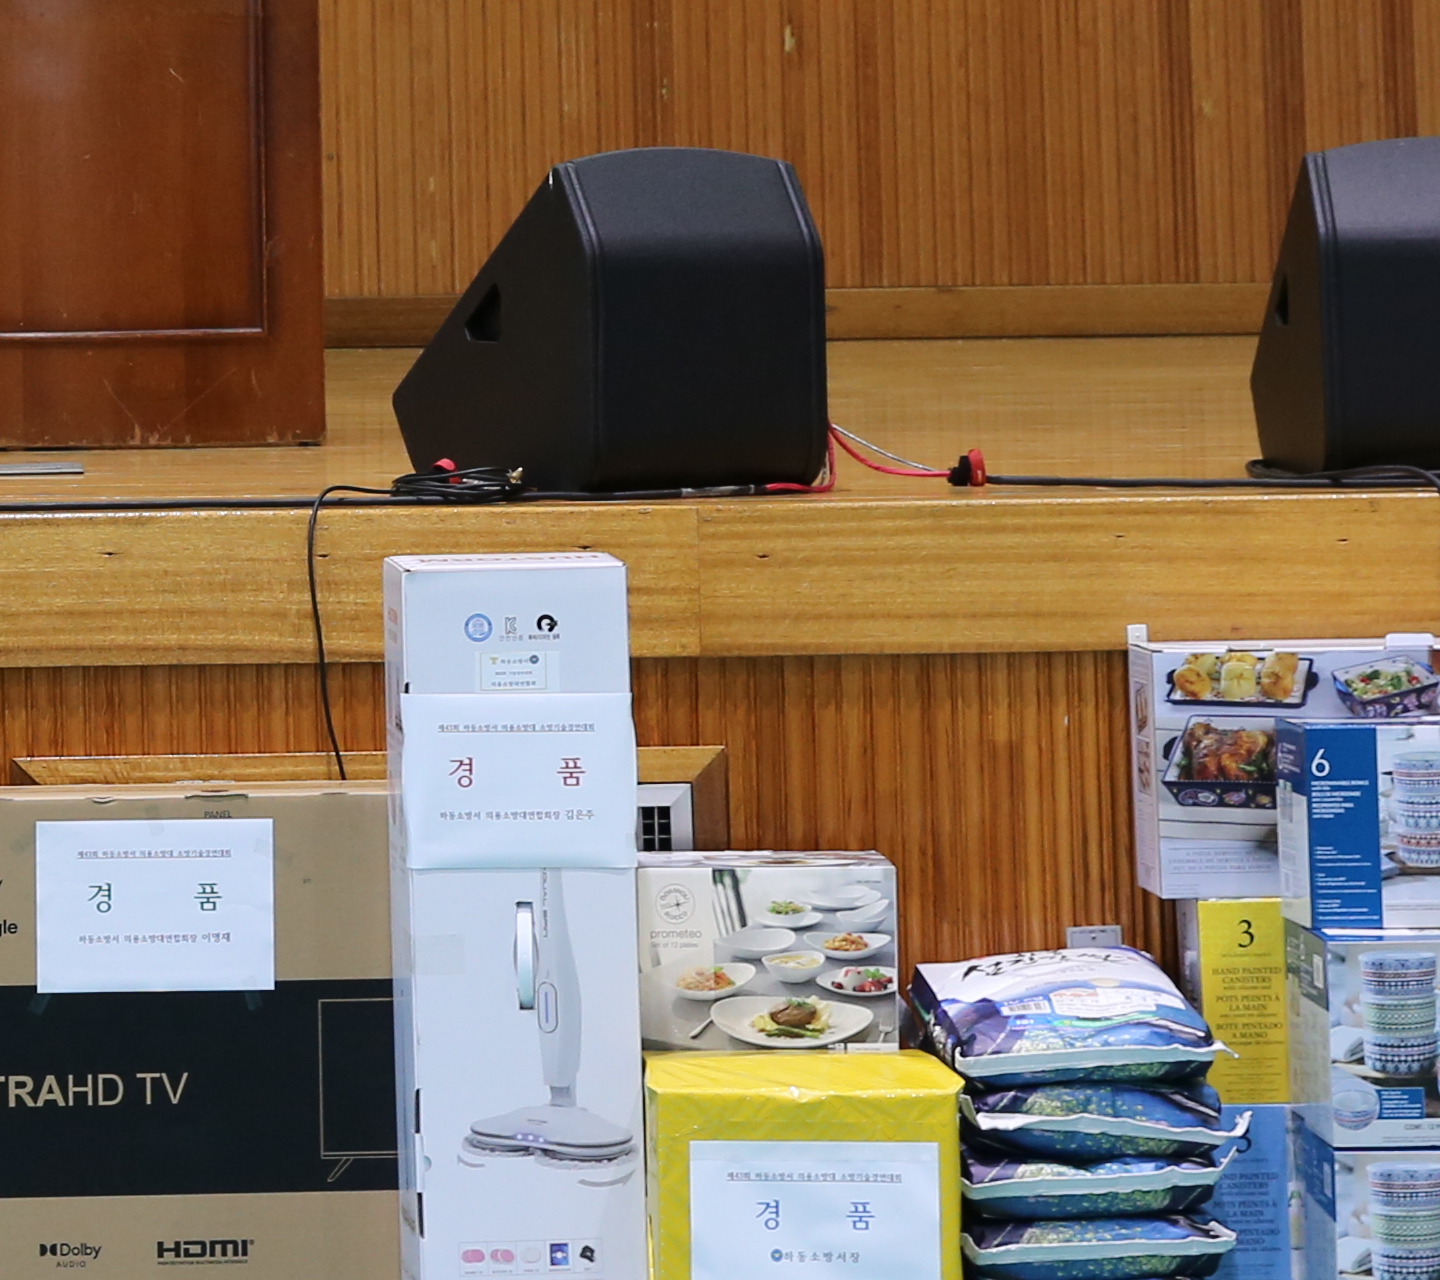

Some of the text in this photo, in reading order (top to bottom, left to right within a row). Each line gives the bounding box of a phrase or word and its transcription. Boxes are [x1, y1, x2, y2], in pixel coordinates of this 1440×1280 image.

[448, 756, 586, 788] 경 품
[1310, 748, 1331, 778] 6
[87, 882, 224, 914] 경 품
[649, 928, 703, 940] prometeo
[1236, 919, 1255, 948] 3
[135, 1071, 189, 1106] TV
[755, 1199, 876, 1231] 경 품
[58, 1242, 103, 1261] Dolby
[156, 1239, 249, 1259] HDMI
[784, 1251, 861, 1264] 하동소방서장
[56, 1260, 87, 1269] AUDIO
